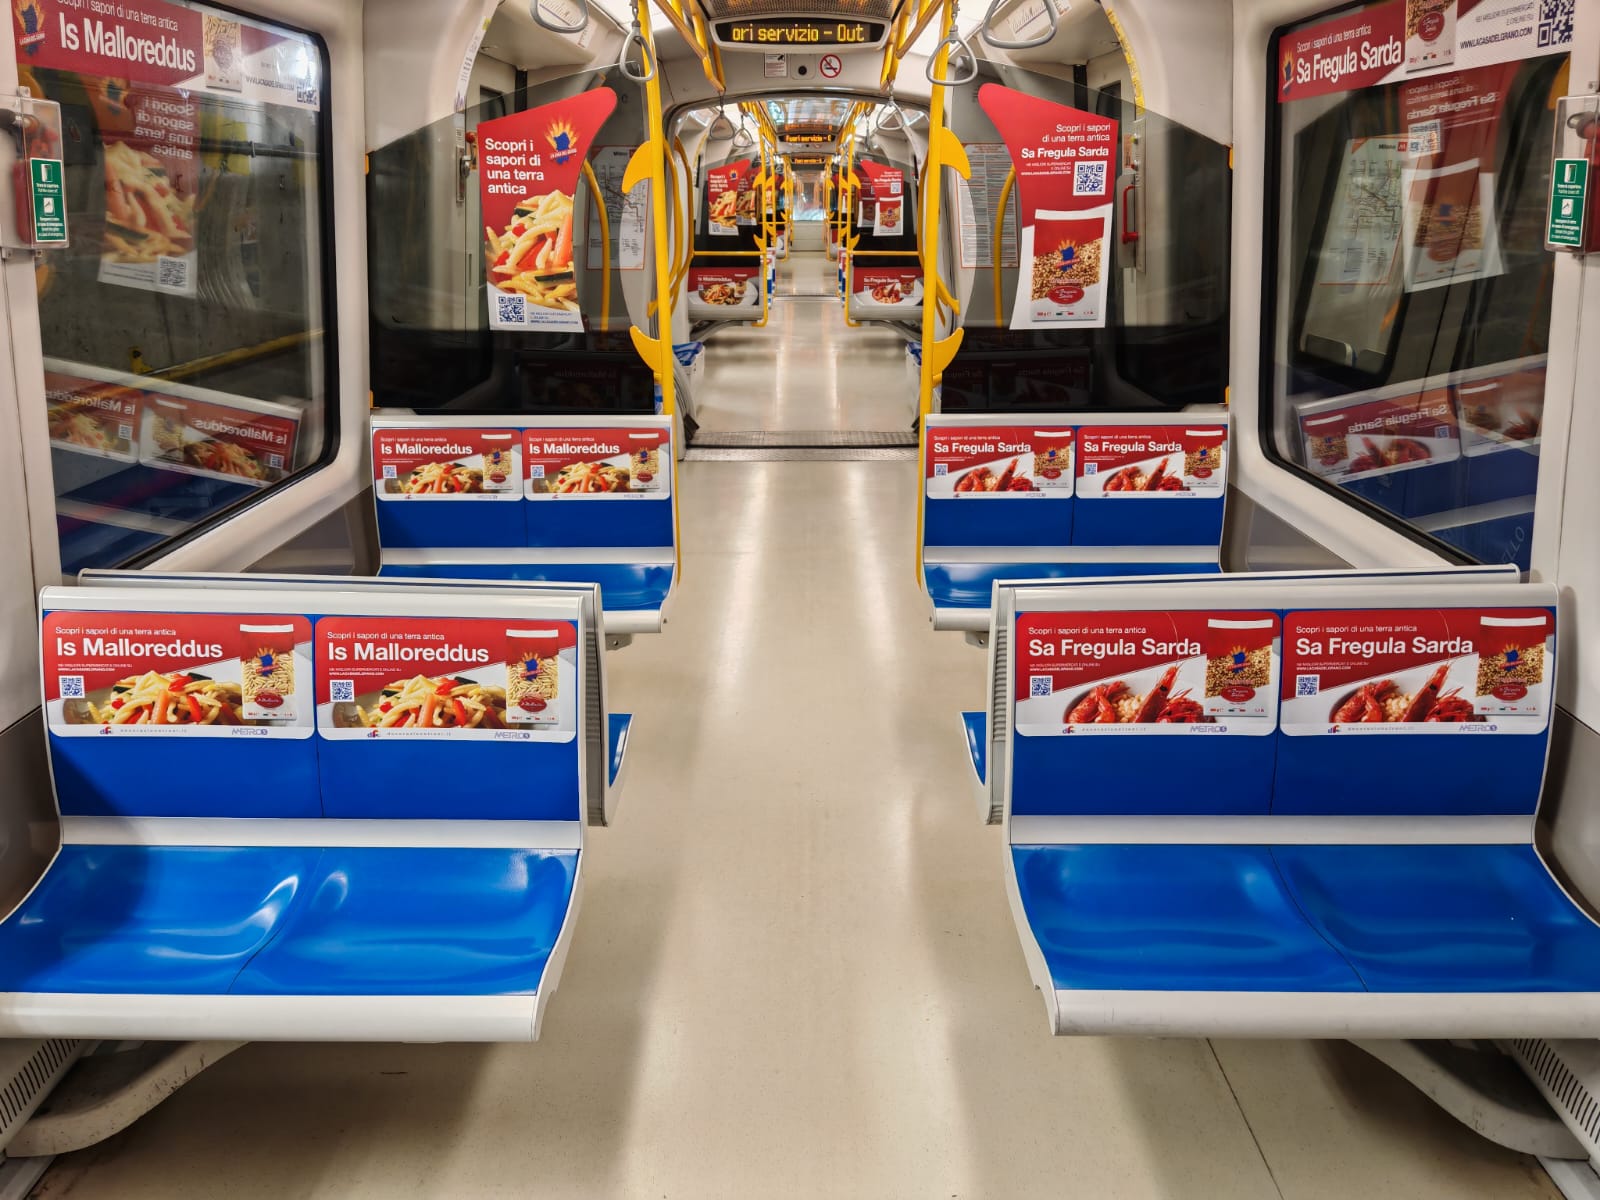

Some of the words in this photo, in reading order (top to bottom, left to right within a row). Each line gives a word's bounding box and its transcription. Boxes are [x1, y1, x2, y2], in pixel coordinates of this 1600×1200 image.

[90, 2, 115, 16] sapori
[117, 4, 124, 16] di
[125, 9, 139, 21] una
[140, 12, 157, 25] terra
[158, 16, 178, 31] antica
[732, 24, 753, 41] ori
[758, 23, 819, 42] servizio
[837, 24, 865, 42] Out
[1333, 33, 1342, 43] una
[1343, 30, 1355, 41] terra
[1355, 24, 1372, 38] antica
[1460, 26, 1532, 49] WWW.LACASADELGRANO.COM
[59, 12, 80, 50] Is
[84, 18, 196, 72] Malloreddus
[1296, 58, 1310, 84] Sa
[1313, 45, 1357, 84] Fregula
[1360, 35, 1401, 71] Sarda
[1056, 123, 1081, 134] Scopri
[1087, 123, 1110, 133] sapori
[1042, 134, 1050, 143] di
[1067, 134, 1085, 142] terra
[1087, 133, 1110, 142] antica
[485, 138, 527, 153] Scopri
[530, 139, 533, 150] i
[1021, 148, 1034, 159] Sa
[1038, 147, 1076, 160] Fregula
[1078, 146, 1109, 157] Sarda
[486, 154, 526, 168] sapori
[529, 154, 541, 167] di
[487, 170, 511, 180] una
[514, 168, 544, 181] terra
[488, 183, 527, 194] antica
[381, 444, 392, 454] Is
[395, 444, 472, 454] Malloreddus
[529, 443, 540, 454] Is
[544, 443, 620, 454] Malloreddus
[934, 443, 948, 452] Sa
[952, 442, 994, 455] Fregula
[998, 442, 1031, 452] Sarda
[1084, 442, 1099, 452] Sa
[1102, 442, 1145, 454] Fregula
[1148, 441, 1182, 451] Sarda
[55, 627, 80, 636] Scopri
[85, 627, 108, 636] sapori
[110, 627, 117, 635] di
[153, 628, 176, 636] antica
[327, 631, 352, 641] Scopri
[356, 632, 379, 641] sapori
[1028, 627, 1053, 636] Scopri
[1058, 627, 1080, 636] sapori
[1124, 626, 1146, 634] antica
[1296, 626, 1321, 635] Scopri
[1326, 625, 1349, 635] sapori
[1394, 624, 1417, 632] antica
[57, 638, 76, 656] Is
[83, 638, 223, 658] Malloreddus
[328, 643, 347, 661] Is
[354, 643, 489, 662] Malloreddus
[1029, 639, 1054, 656] Sa
[1061, 638, 1136, 660] Fregula
[1142, 638, 1201, 656] Sarda
[1296, 637, 1322, 655] Sa
[1329, 636, 1406, 659] Fregula
[1412, 635, 1473, 654] Sarda
